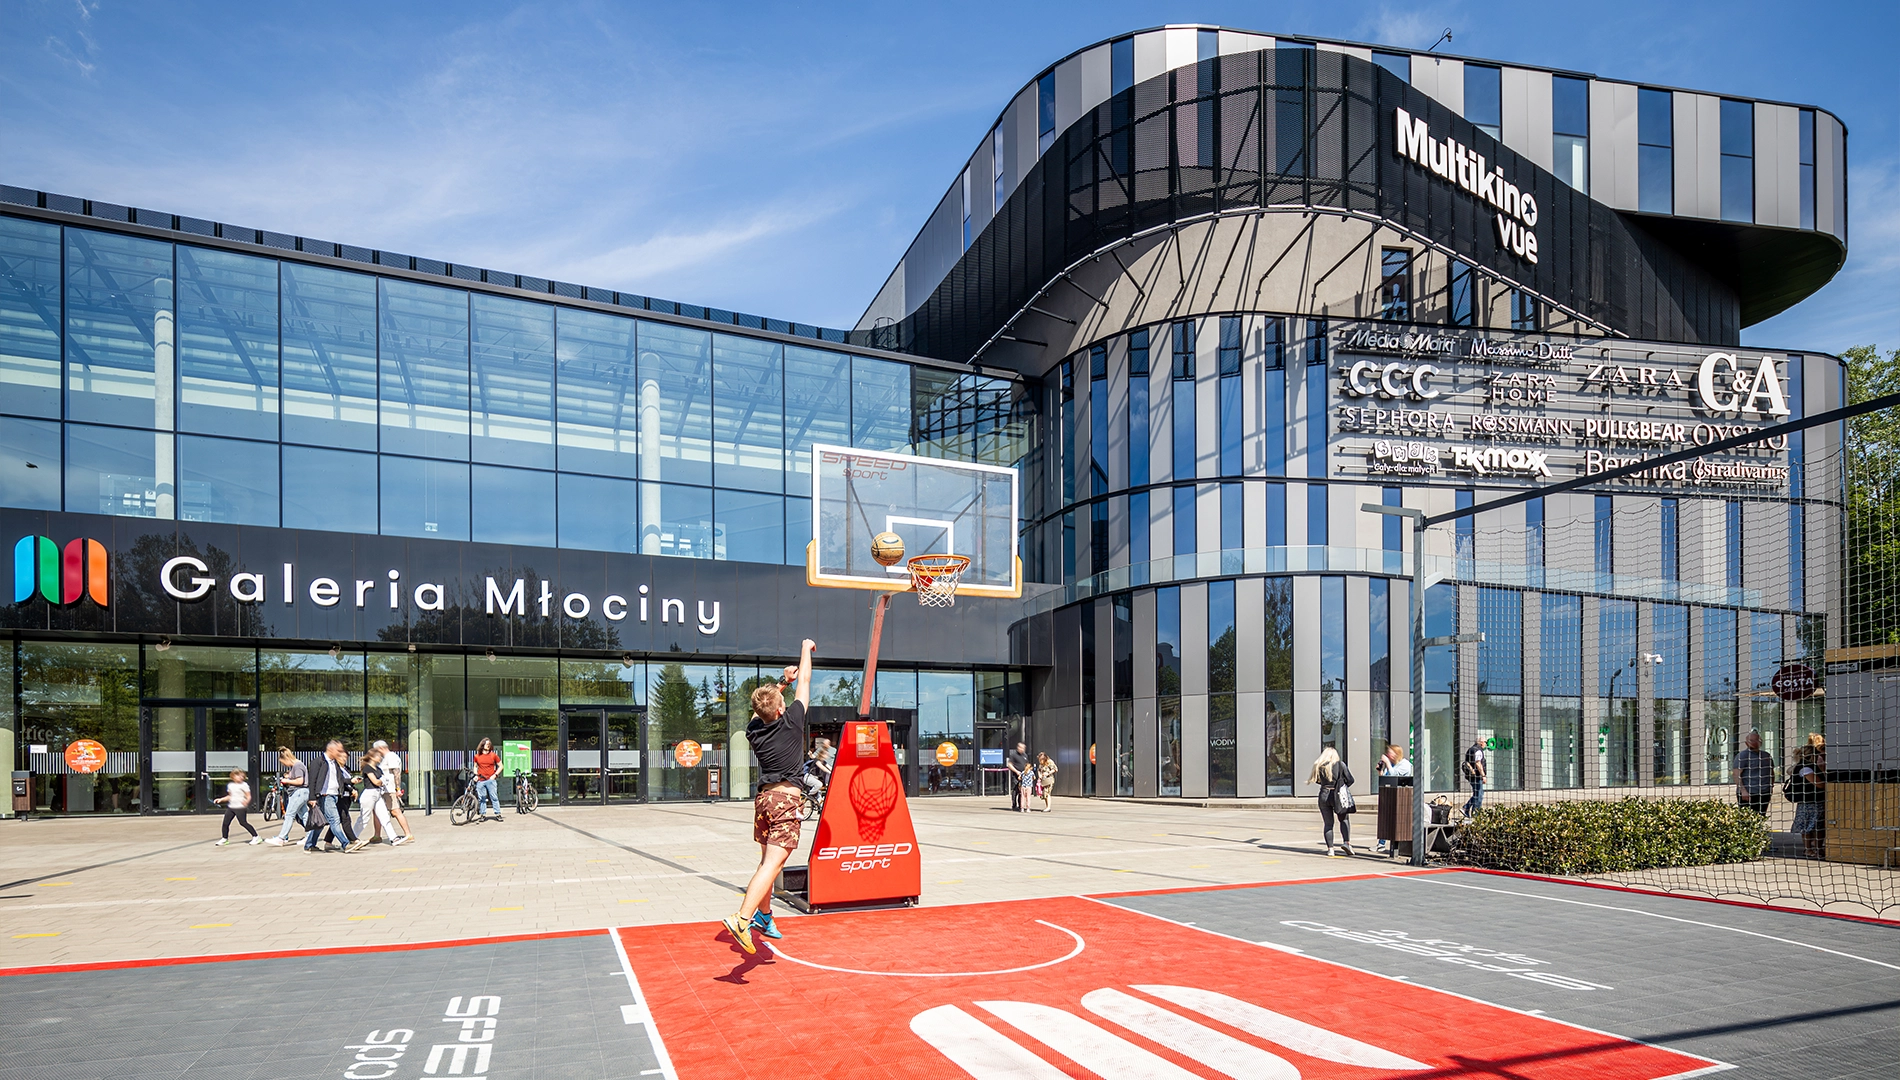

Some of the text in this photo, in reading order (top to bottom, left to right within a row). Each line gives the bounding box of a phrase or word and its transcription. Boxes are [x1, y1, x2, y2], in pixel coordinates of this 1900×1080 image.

[1397, 106, 1538, 227] Multikino
[1497, 213, 1538, 264] vue
[1470, 338, 1575, 360] Massimo Dutti
[1350, 360, 1440, 399] CCC
[1492, 372, 1557, 387] ZARA
[1587, 363, 1684, 388] ZARA
[1698, 352, 1791, 416] C&A
[1492, 388, 1557, 403] HOME
[1346, 408, 1455, 430] SEPHORA
[1471, 415, 1573, 435] ROSSMANN
[1586, 419, 1686, 442] PULL&BEAR
[821, 452, 908, 471] SPEED
[1586, 450, 1686, 481] Bershka
[842, 468, 888, 481] sport
[160, 556, 721, 635] Galeria Młociny
[1775, 677, 1813, 688] COSTA
[817, 842, 913, 861] SPEED
[840, 857, 891, 873] sport
[419, 995, 501, 1080] SPE
